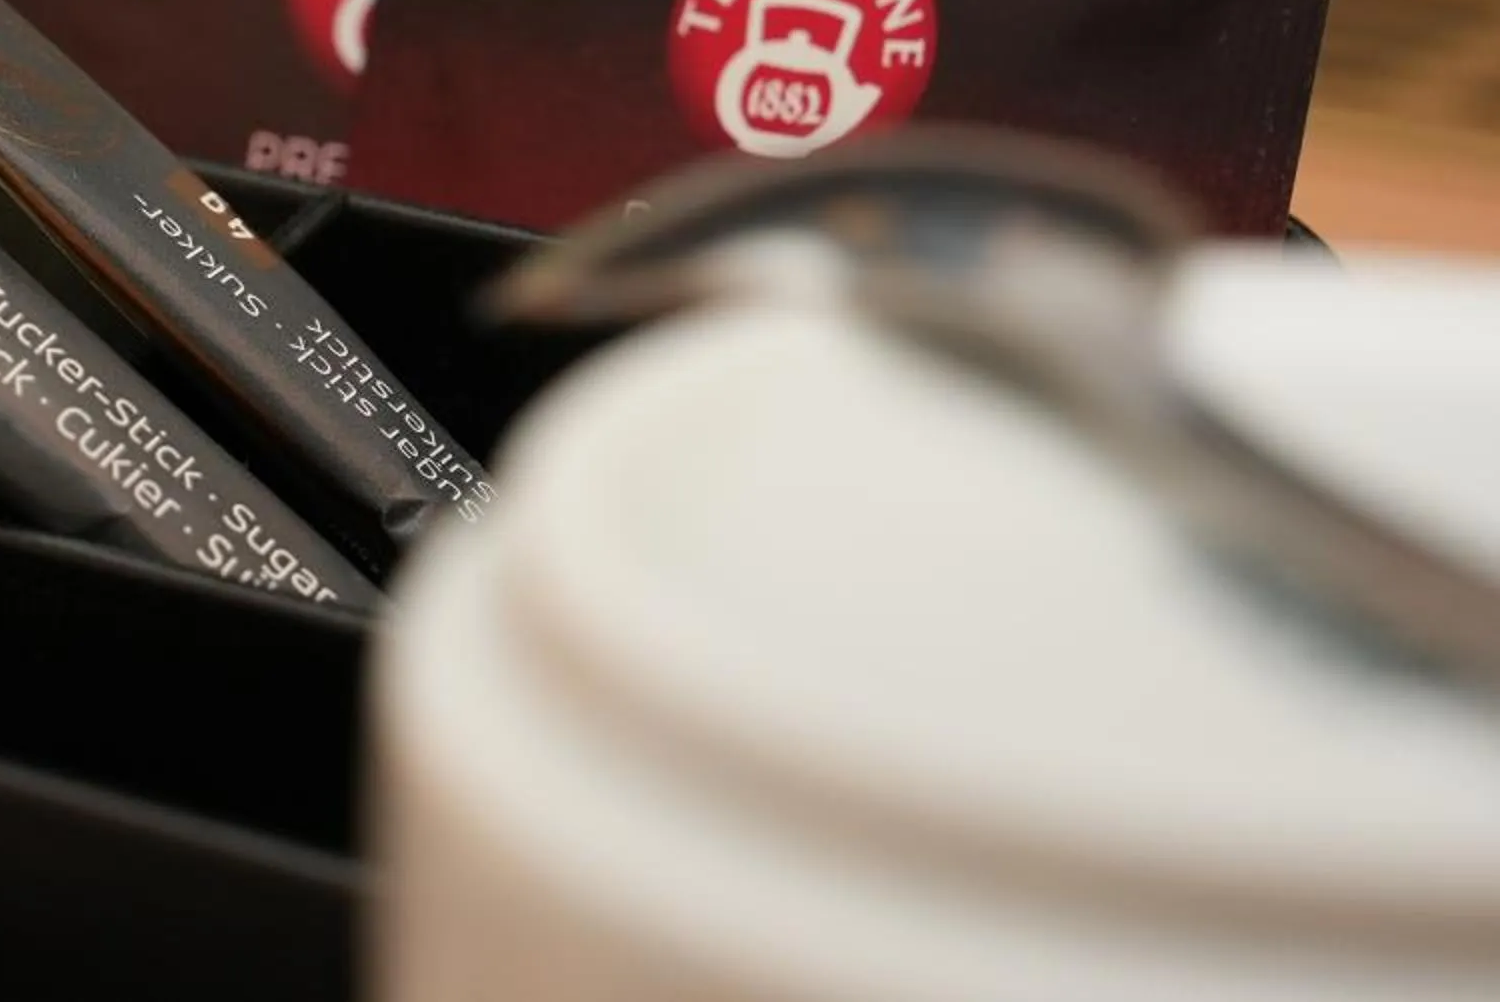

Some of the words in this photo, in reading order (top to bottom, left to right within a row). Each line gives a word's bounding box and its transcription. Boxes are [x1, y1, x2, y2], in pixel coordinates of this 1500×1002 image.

[133, 194, 268, 317] Sukker-
[289, 336, 378, 417] stick
[55, 406, 182, 518] Cukier
[379, 426, 485, 524] Sugar
[222, 503, 339, 602] Sugar
